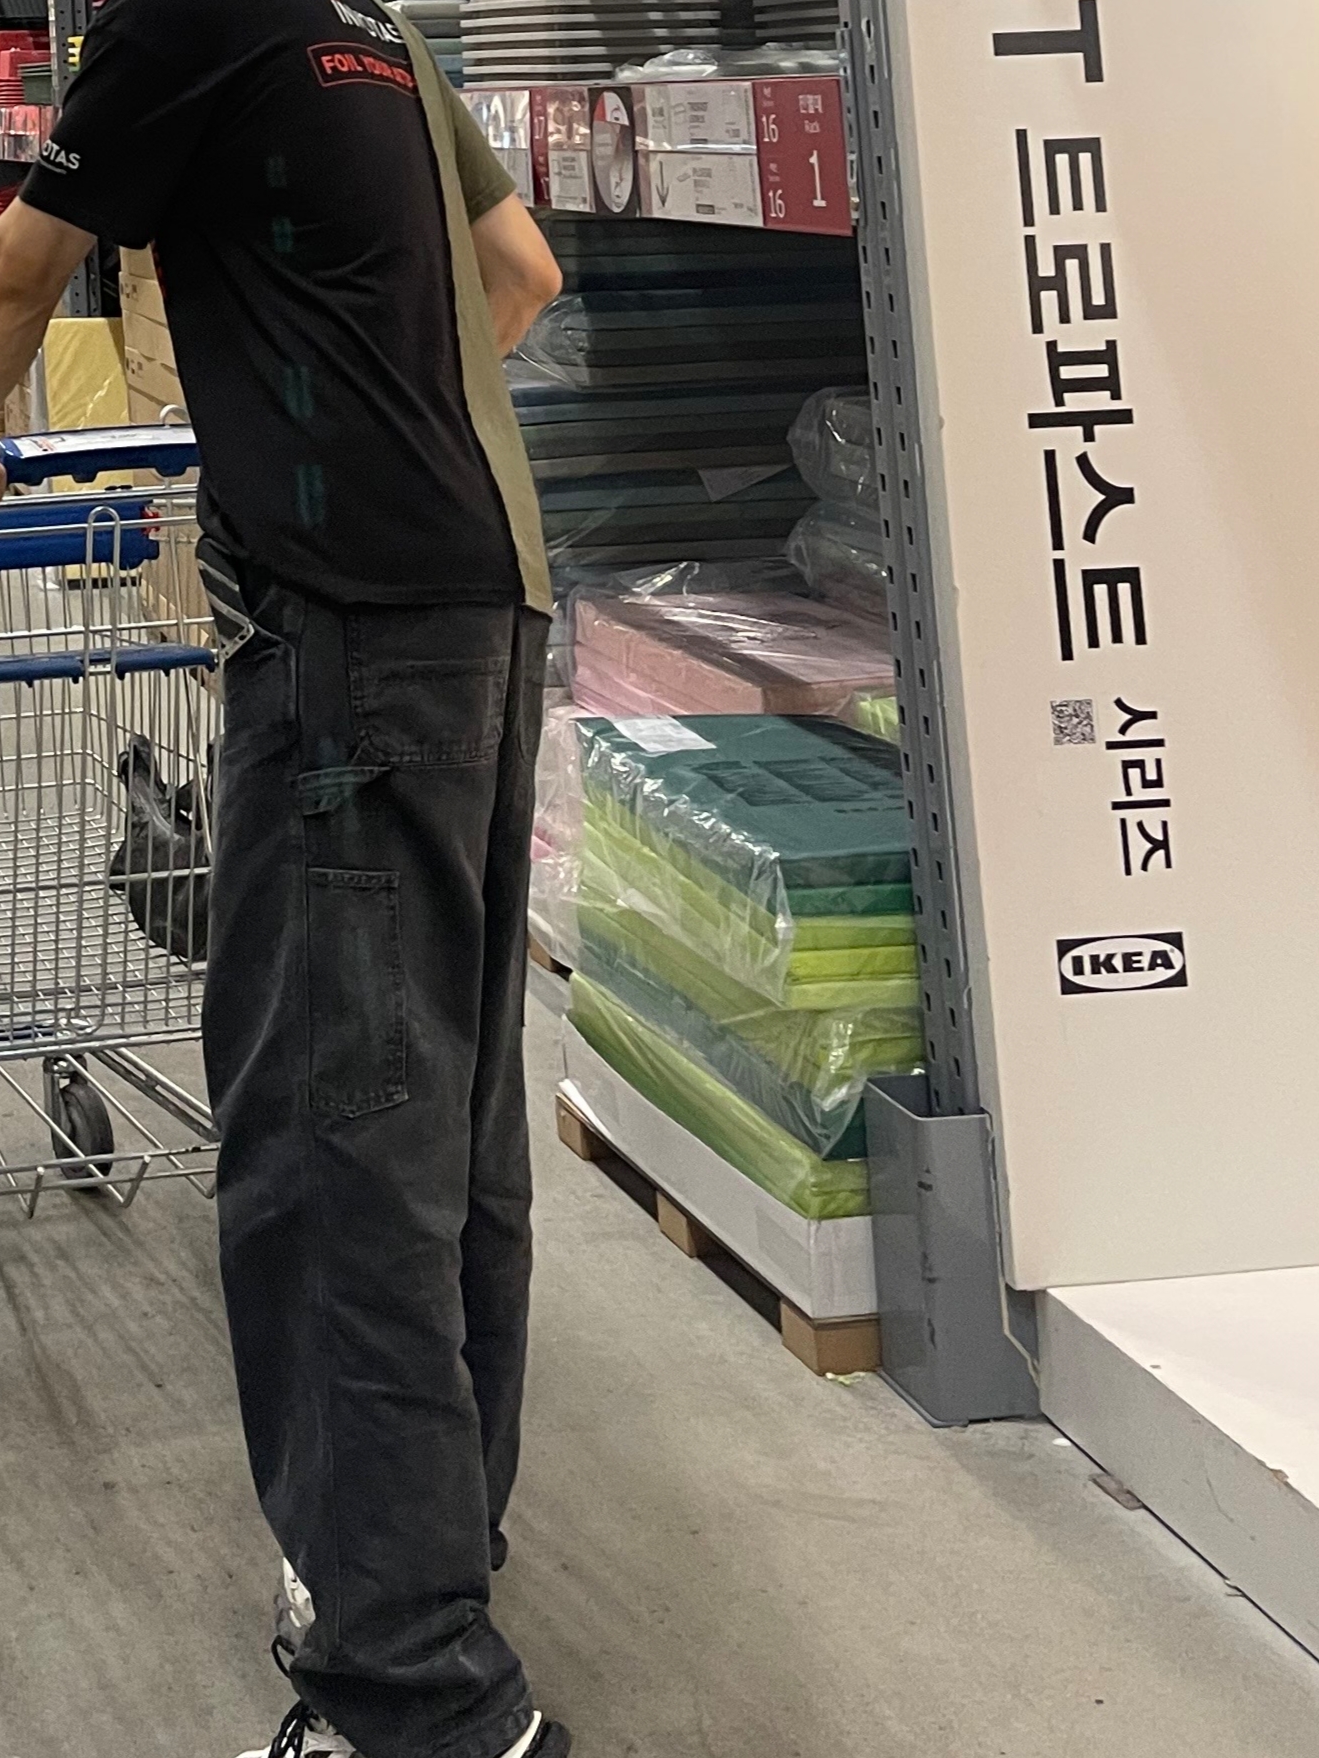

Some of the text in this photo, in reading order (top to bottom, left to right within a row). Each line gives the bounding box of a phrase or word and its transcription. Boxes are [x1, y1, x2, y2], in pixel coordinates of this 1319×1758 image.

[321, 53, 363, 74] FOIL
[761, 114, 779, 143] 16
[809, 150, 827, 207] 1
[768, 189, 786, 218] 16
[1016, 128, 1148, 662] 트로파스트
[1105, 696, 1173, 876] 시리즈
[1071, 948, 1176, 977] IKEA
